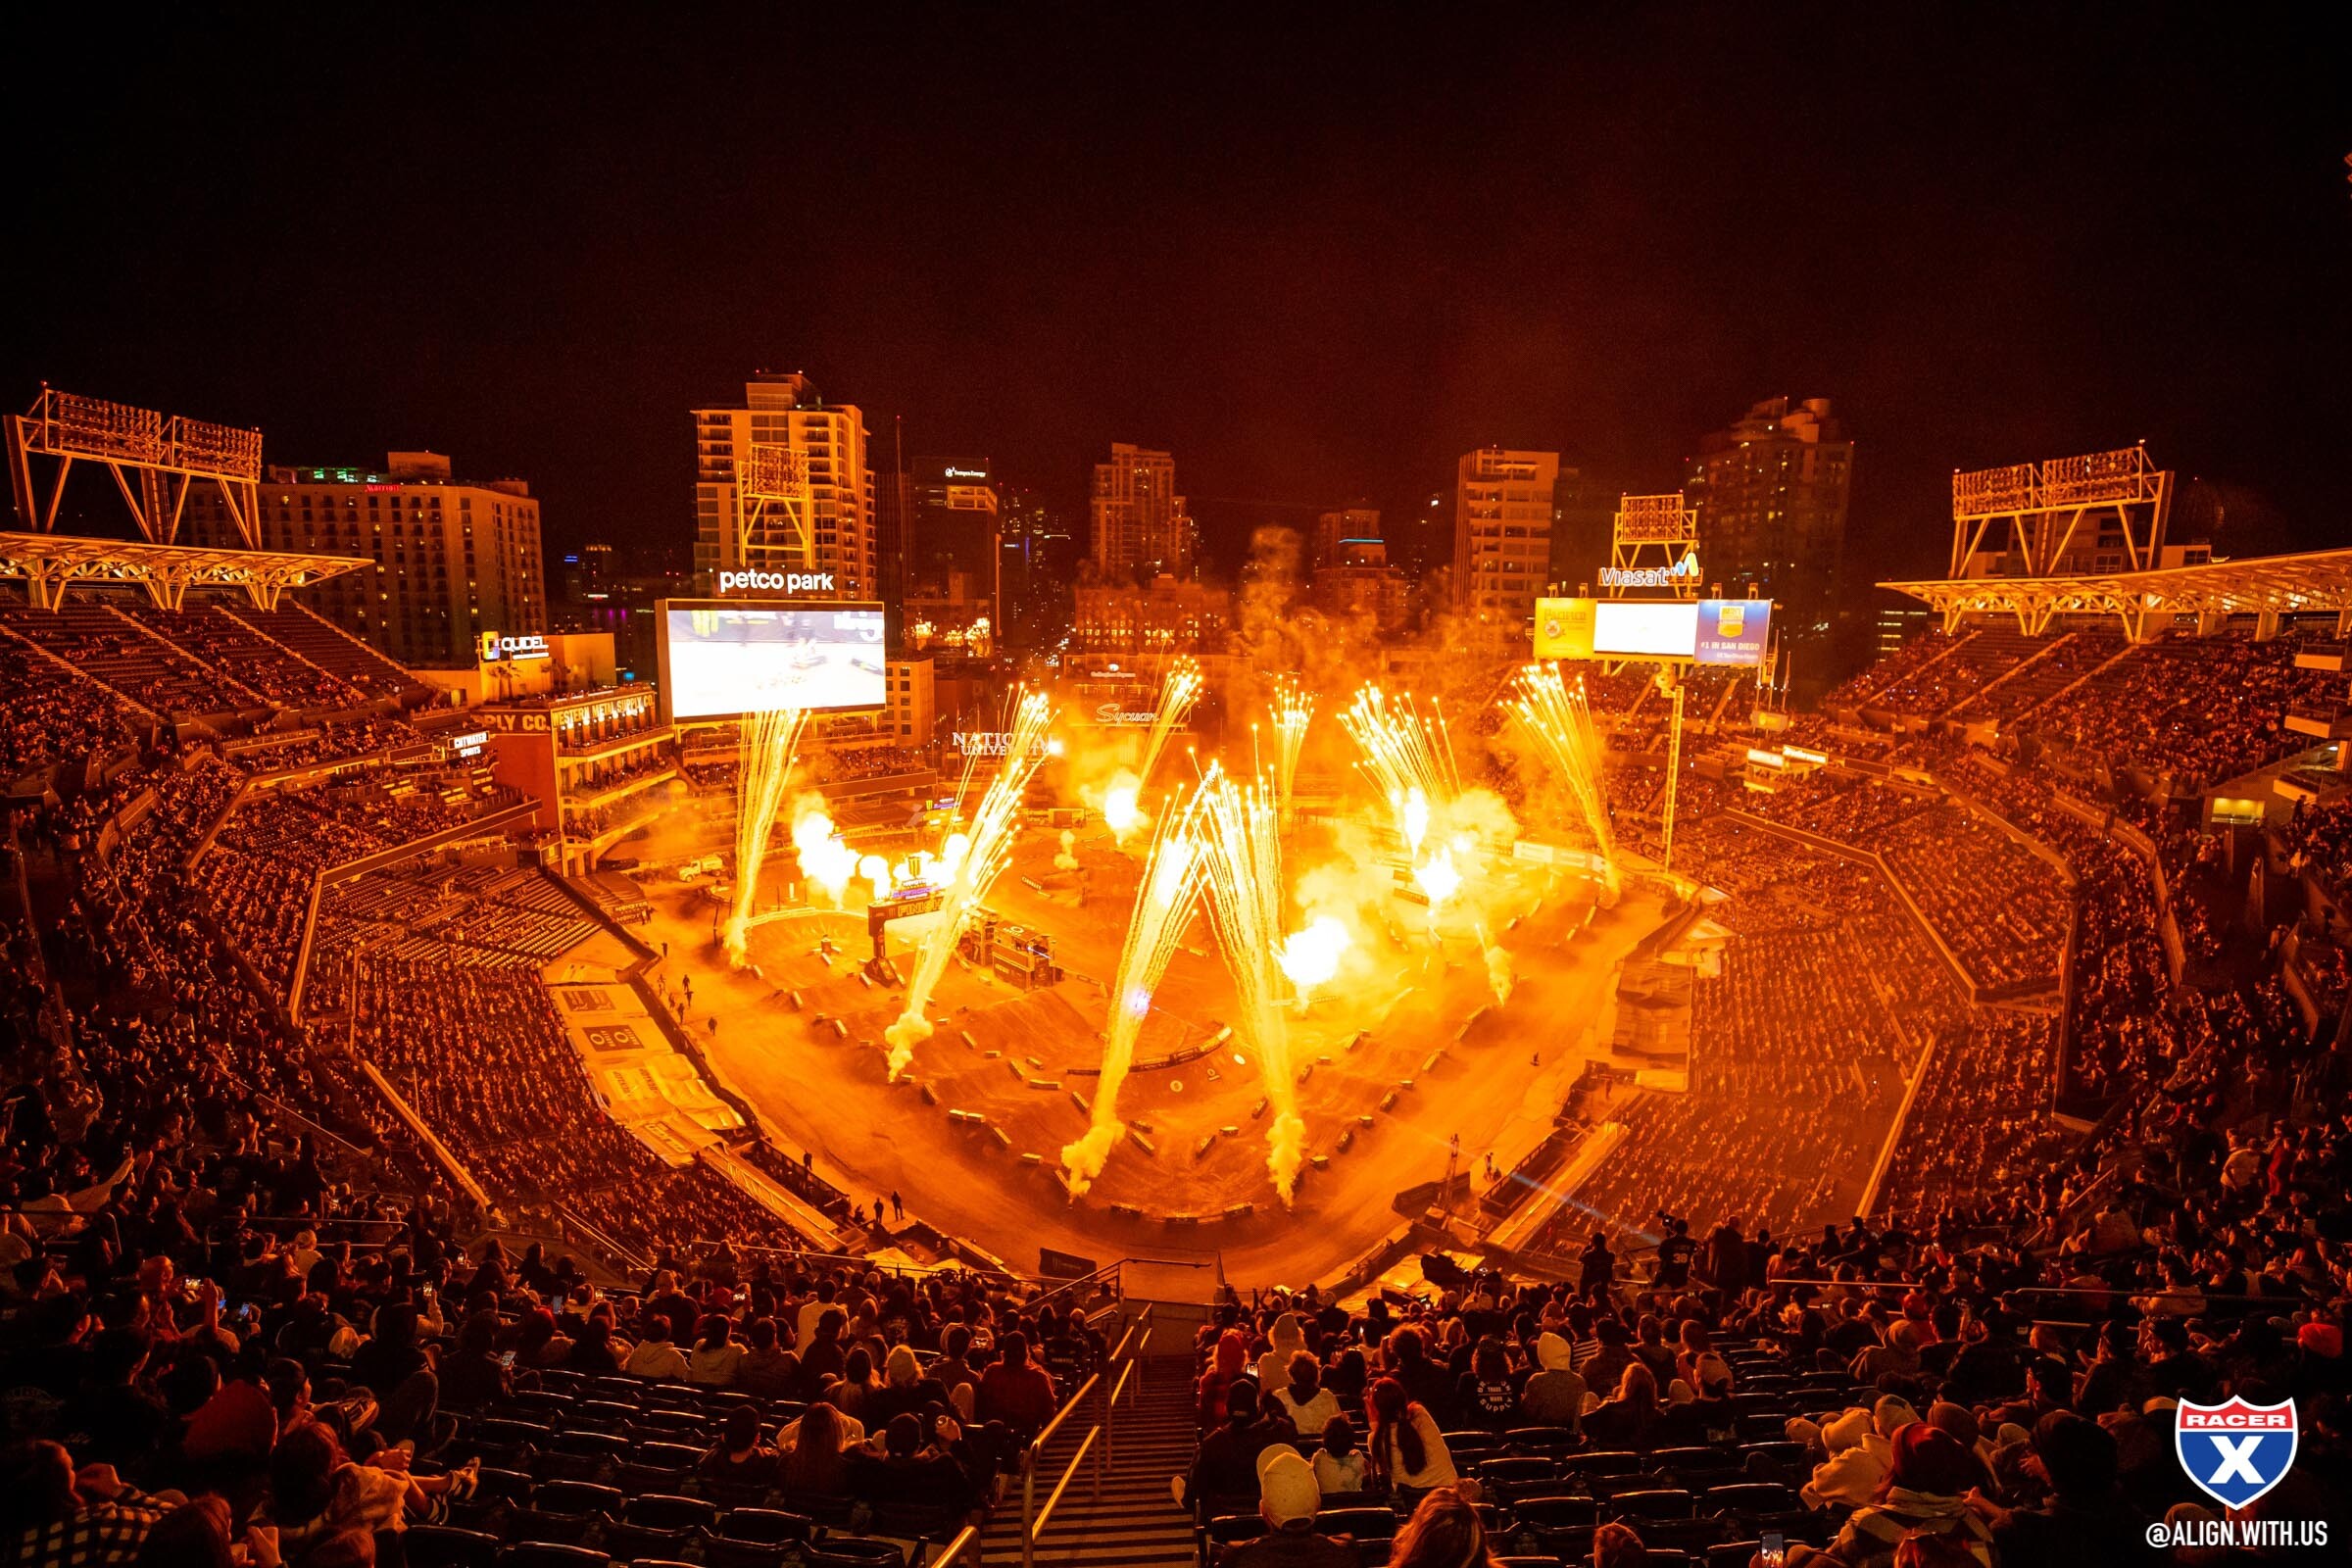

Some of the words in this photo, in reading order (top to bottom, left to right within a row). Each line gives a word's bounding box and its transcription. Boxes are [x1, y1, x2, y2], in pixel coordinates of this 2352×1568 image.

[719, 568, 785, 593] petco
[787, 572, 835, 594] park
[1601, 566, 1669, 587] Viasat
[502, 636, 549, 652] QUIDEL
[550, 707, 590, 726] WESTERN
[591, 701, 617, 718] METAL
[616, 696, 644, 713] SUPPLY
[1096, 704, 1159, 726] Sycuan
[522, 714, 551, 731] CO.
[1673, 1253, 1688, 1263] 38
[1480, 1396, 1512, 1412] SUPPLY
